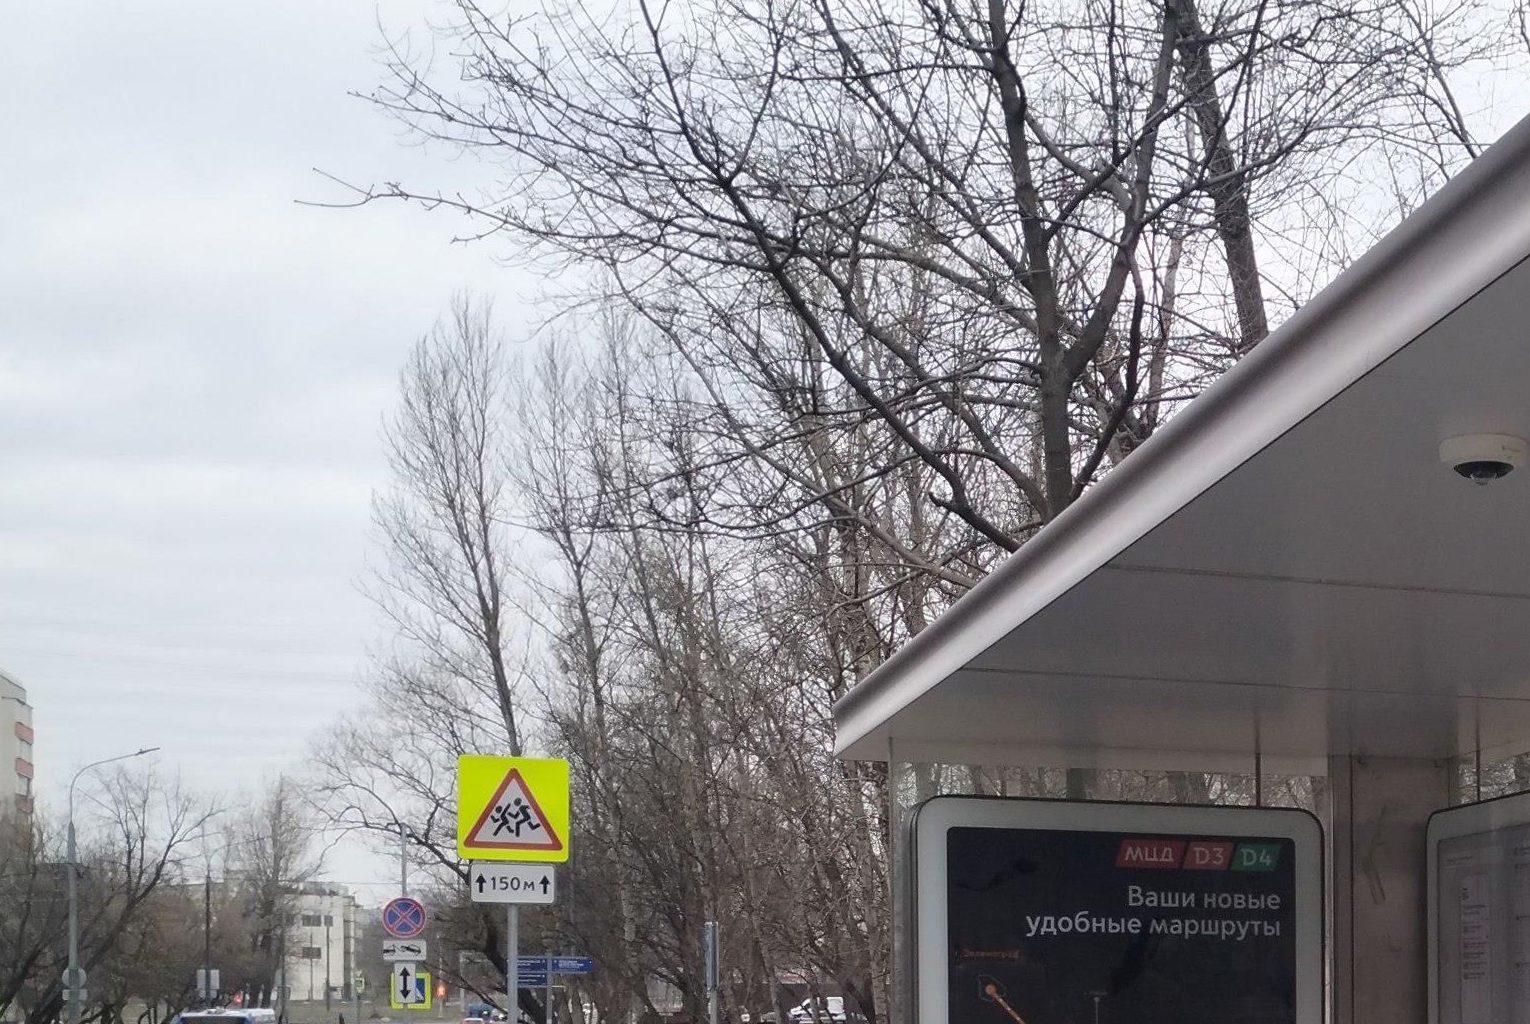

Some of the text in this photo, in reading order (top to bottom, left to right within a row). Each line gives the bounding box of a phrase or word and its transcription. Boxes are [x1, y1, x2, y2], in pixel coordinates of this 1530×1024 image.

[1123, 846, 1273, 867] МЦД D3 D4
[1127, 884, 1281, 911] Ваши новые
[1025, 911, 1281, 941] удобные маршруты
